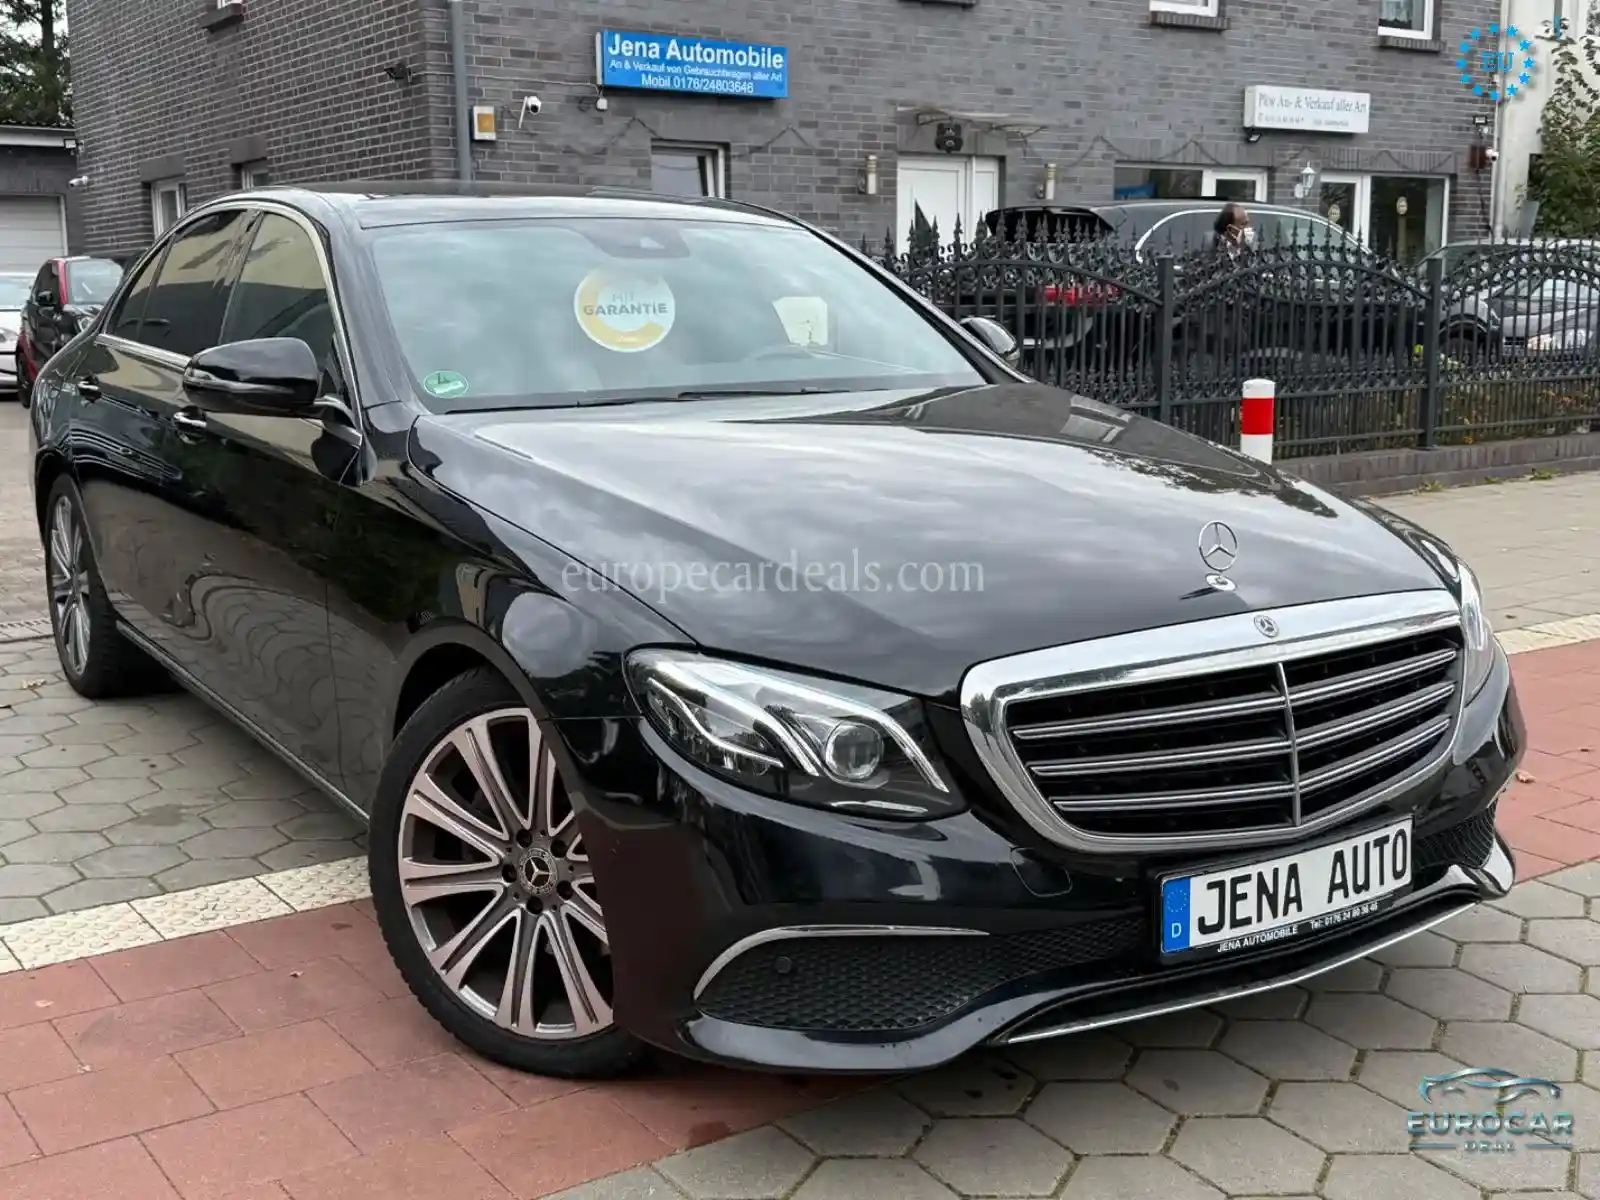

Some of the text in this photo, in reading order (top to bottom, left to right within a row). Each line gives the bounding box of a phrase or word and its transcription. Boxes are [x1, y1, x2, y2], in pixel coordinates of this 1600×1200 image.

[608, 33, 784, 69] Jena Automobile
[609, 60, 623, 69] An
[624, 60, 632, 70] &
[633, 60, 666, 73] Verkauf
[667, 64, 682, 73] von
[683, 64, 752, 81] Gebrauchtwagen
[641, 73, 671, 89] Mobil
[583, 301, 669, 317] GARANTIE
[1197, 828, 1408, 936] JENA AUTO
[1171, 922, 1183, 938] D
[1217, 938, 1241, 953] JENA
[1242, 924, 1299, 947] AUTOMOBILE
